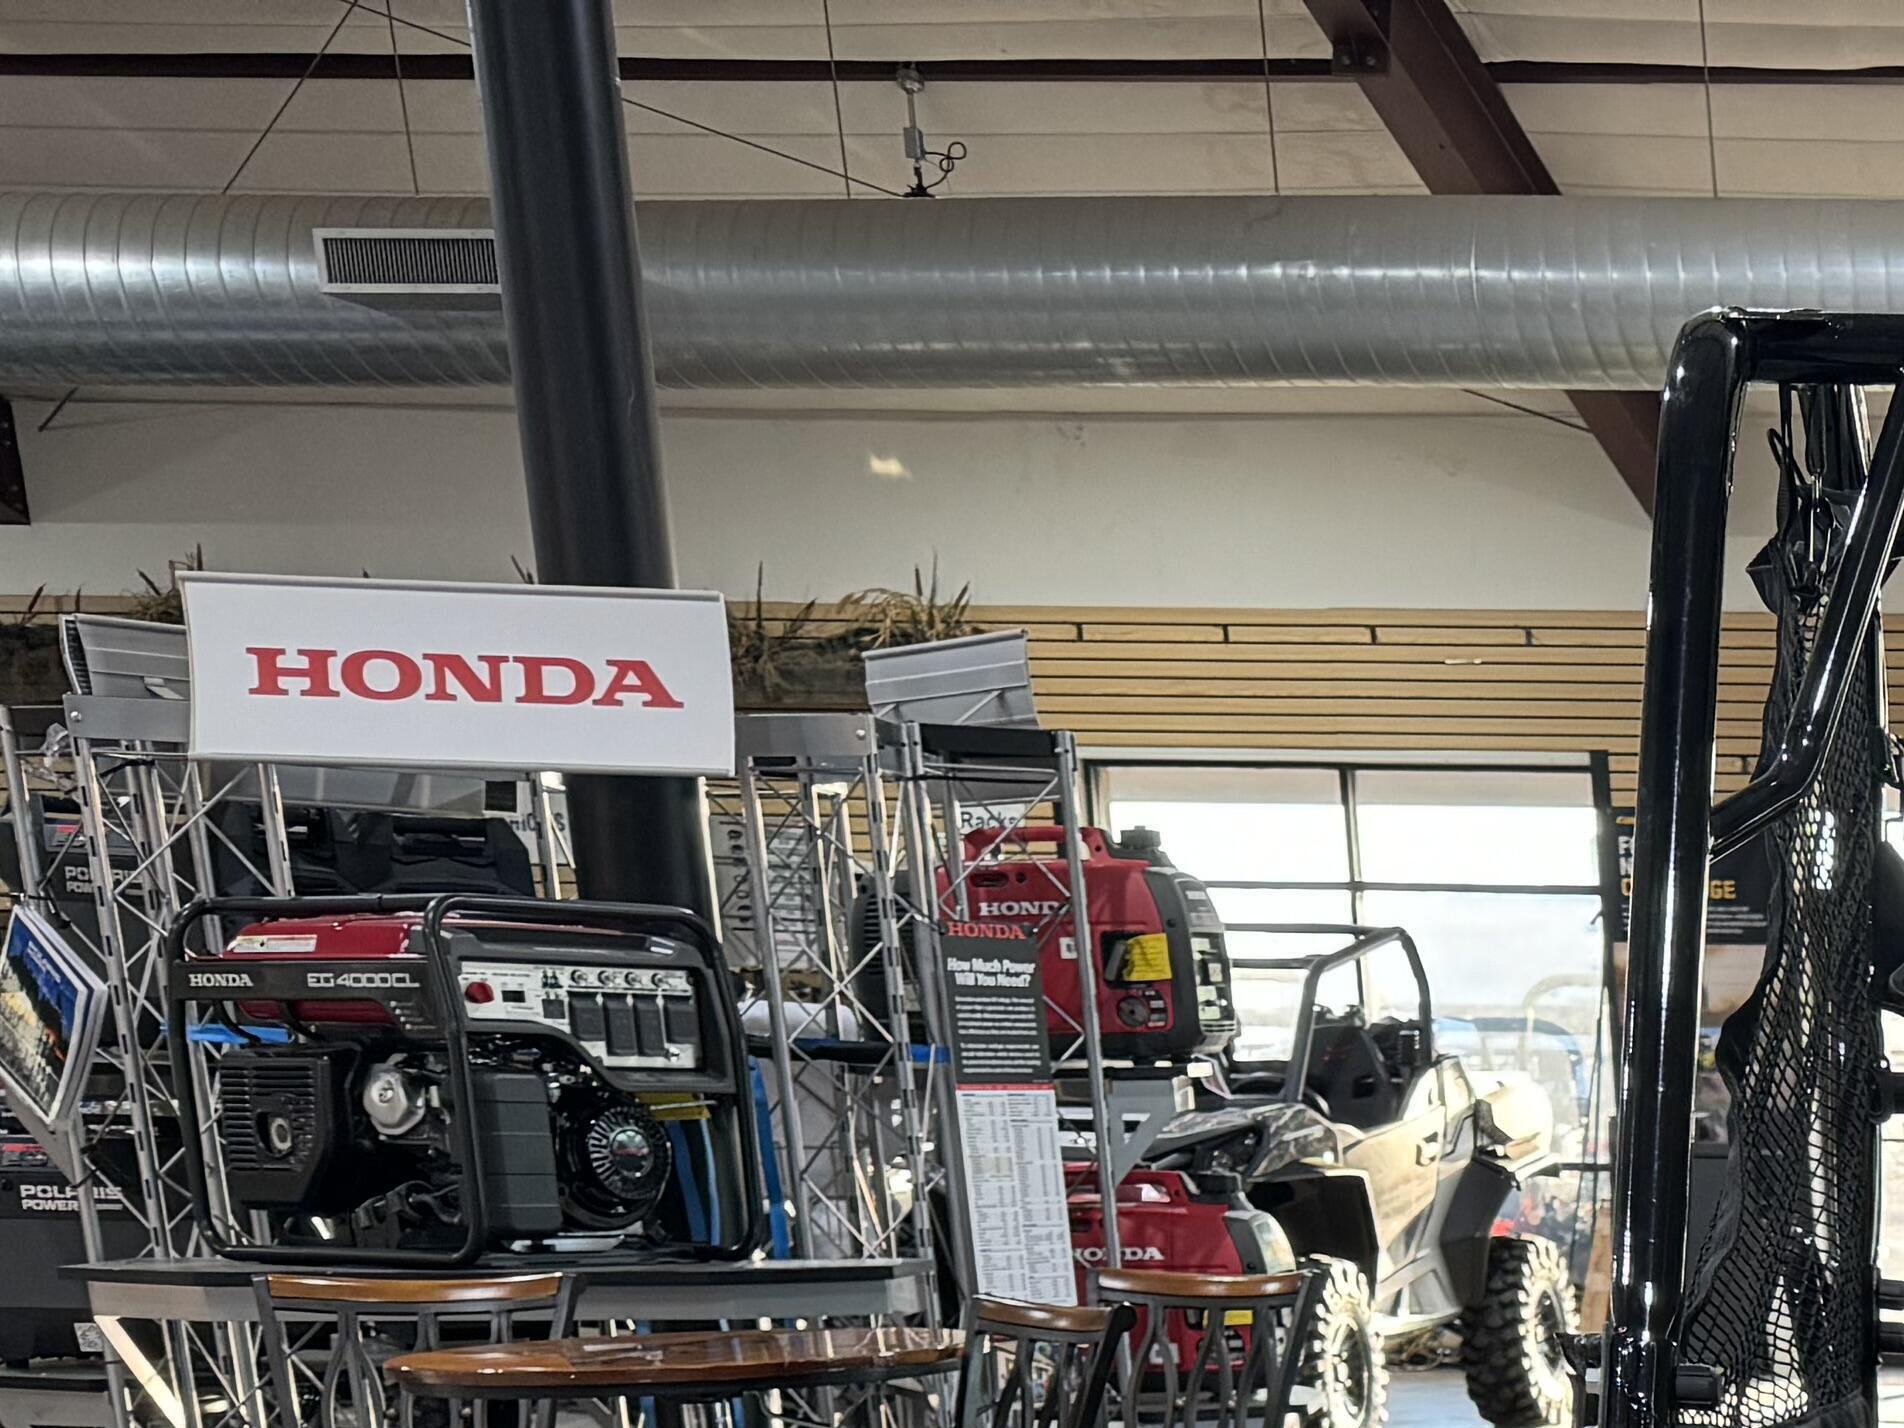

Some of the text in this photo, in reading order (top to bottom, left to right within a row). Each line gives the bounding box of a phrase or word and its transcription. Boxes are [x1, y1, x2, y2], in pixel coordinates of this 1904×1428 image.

[246, 646, 684, 710] HONDA
[979, 902, 1064, 917] HOND
[947, 922, 1026, 940] HONDA
[947, 957, 1036, 974] How Much Power
[189, 973, 254, 988] HONDA
[955, 972, 1032, 988] Will You Need?
[1076, 1246, 1165, 1261] ODA
